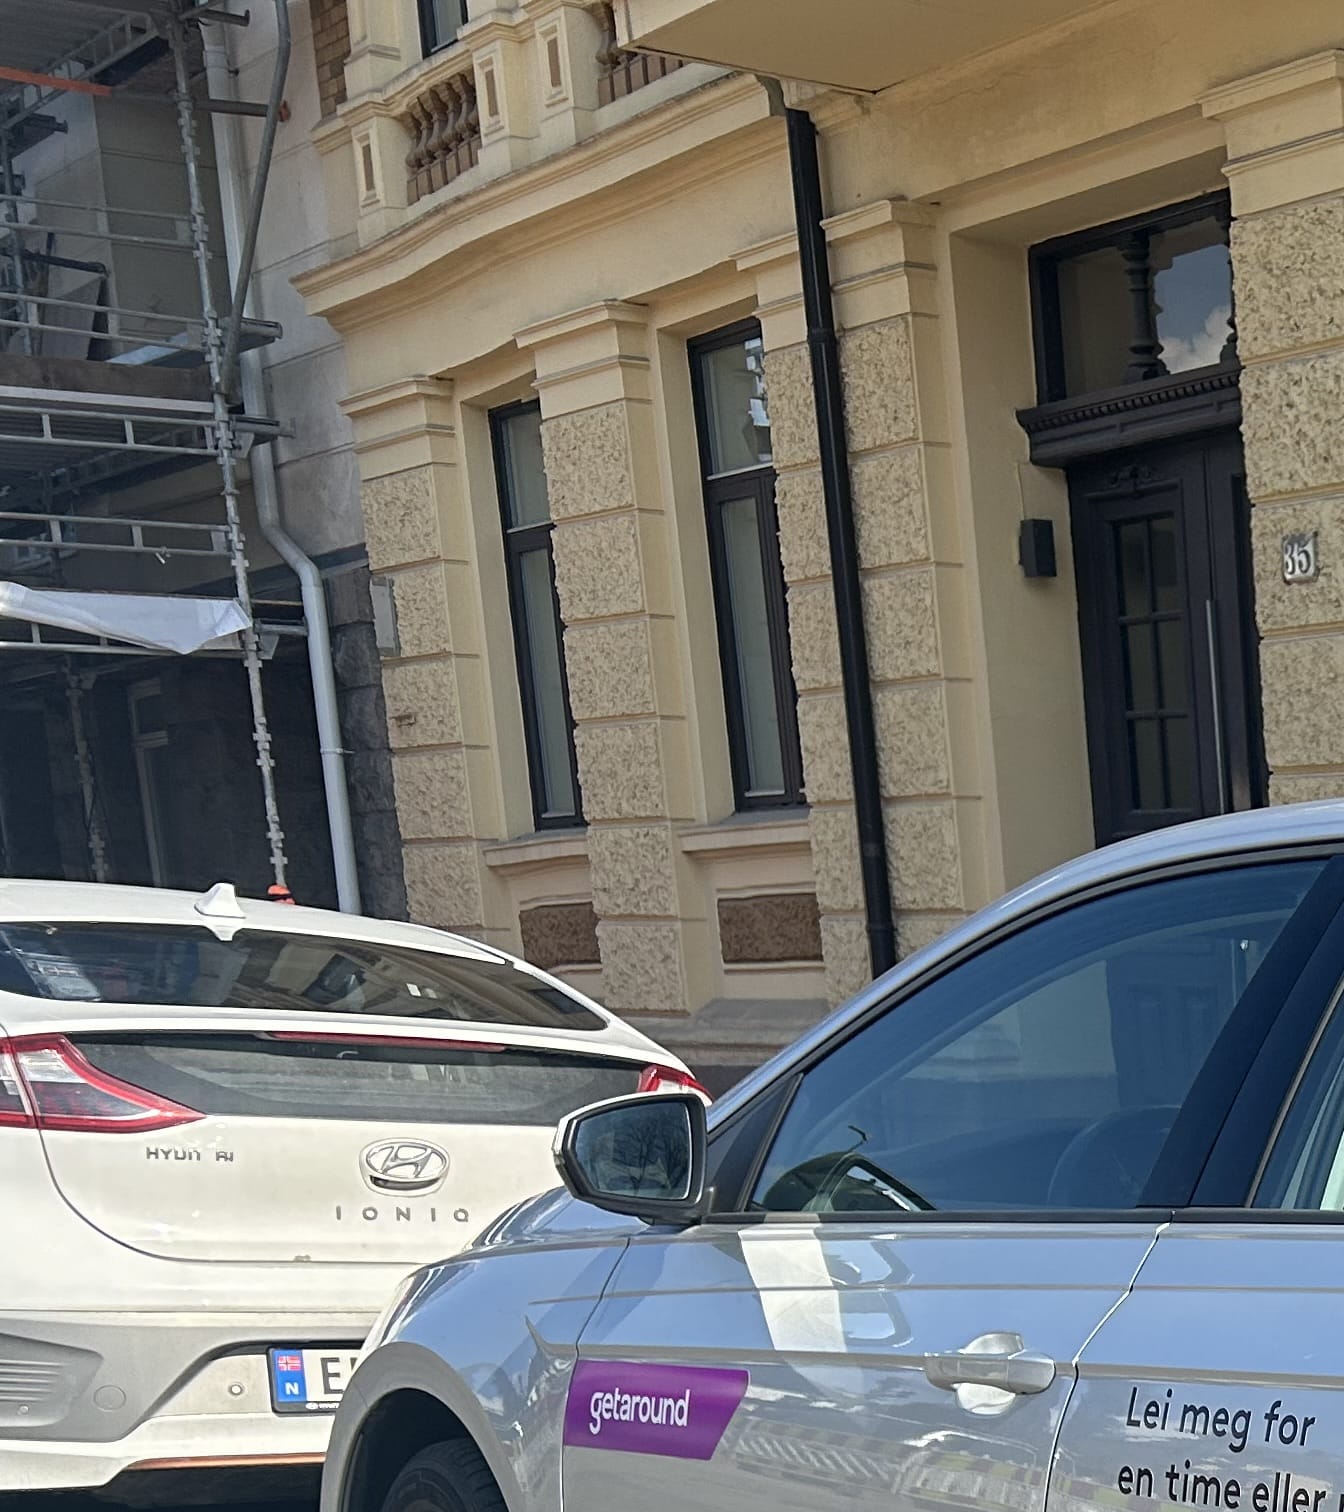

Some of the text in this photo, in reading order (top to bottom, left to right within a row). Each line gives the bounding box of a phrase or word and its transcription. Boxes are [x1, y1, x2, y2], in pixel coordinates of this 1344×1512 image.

[1285, 541, 1311, 575] 35
[146, 1147, 234, 1162] HYUNAI
[335, 1206, 469, 1223] IONIQ
[284, 1382, 299, 1395] N
[589, 1387, 690, 1435] getaround
[1126, 1387, 1316, 1452] Lei meg for
[1118, 1464, 1153, 1497] en
[1165, 1459, 1241, 1509] time
